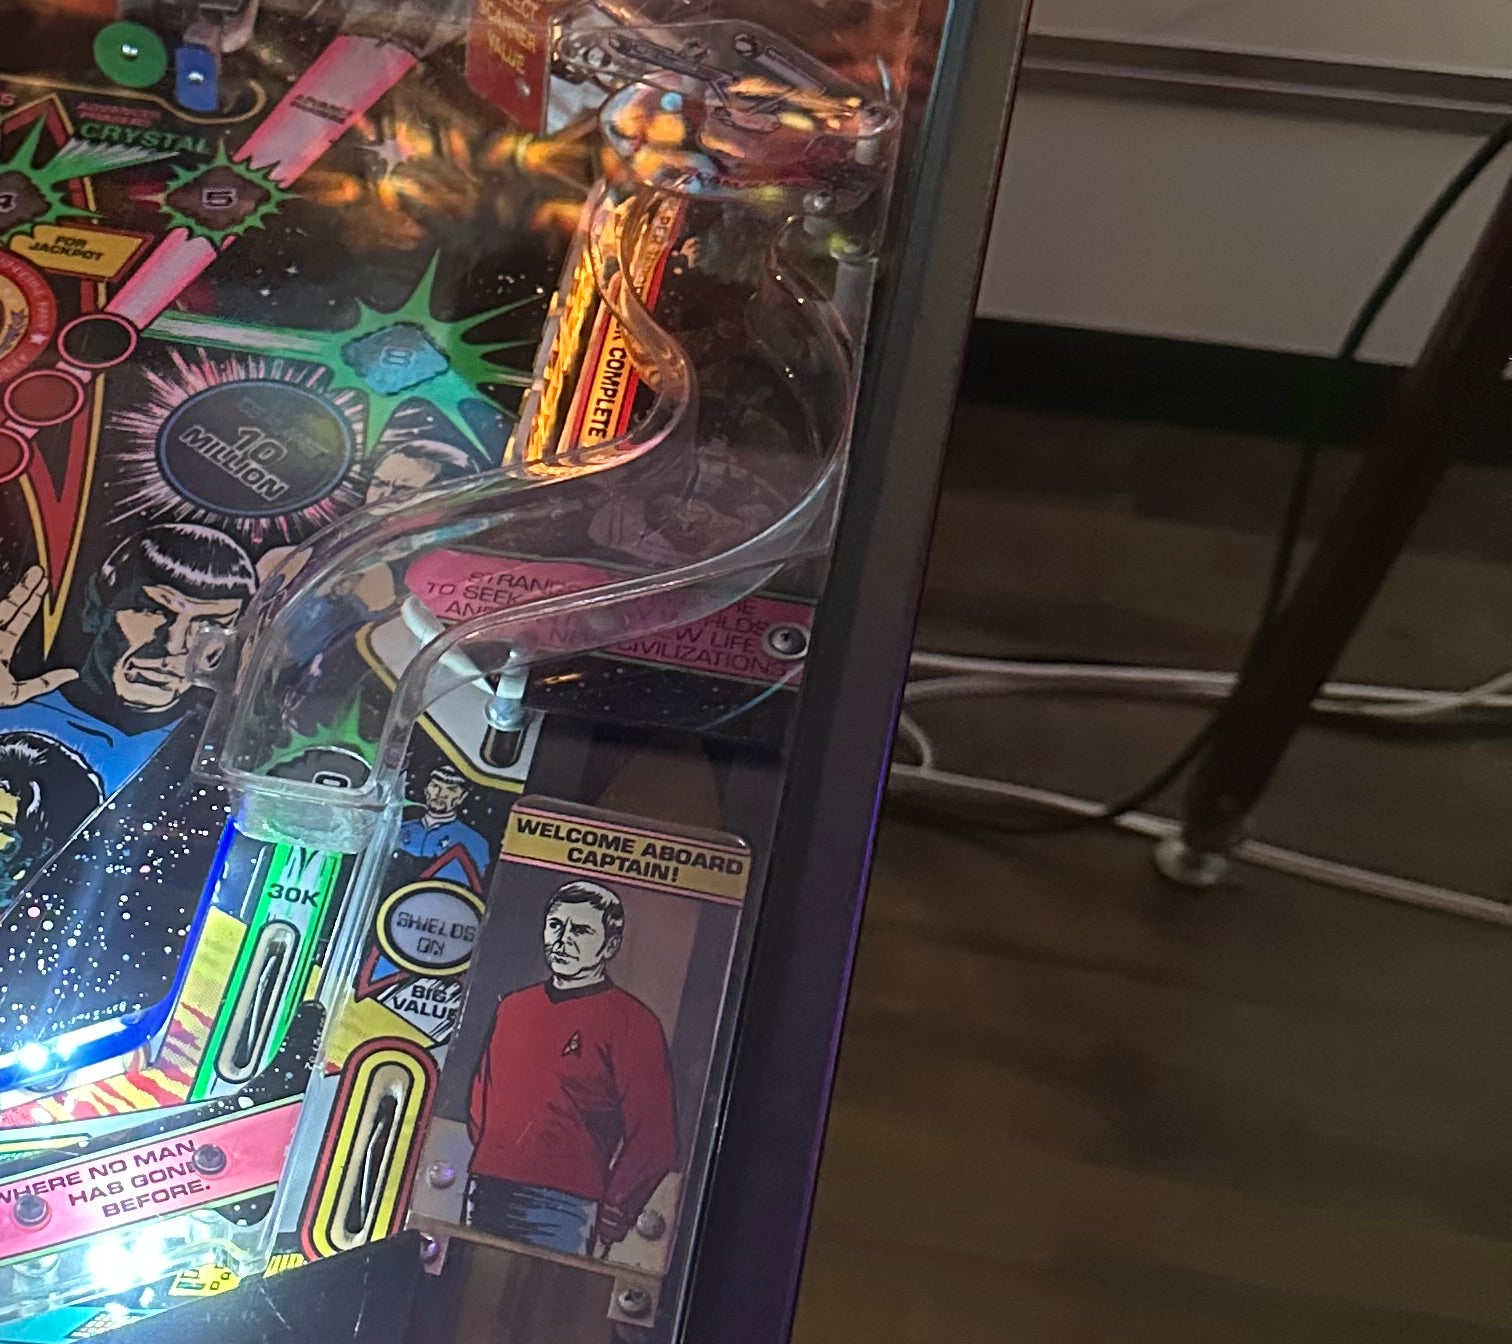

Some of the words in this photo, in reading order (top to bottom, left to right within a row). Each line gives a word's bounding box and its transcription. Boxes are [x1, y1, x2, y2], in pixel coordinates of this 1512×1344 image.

[81, 122, 213, 154] CRYSTAL
[202, 187, 236, 210] 5
[29, 242, 104, 262] JACKPOT
[54, 236, 88, 249] FOR
[588, 346, 627, 439] COMPLETE
[239, 426, 287, 468] 10
[179, 425, 289, 501] MILLION
[427, 582, 455, 595] TO
[710, 632, 758, 652] LIFE
[517, 817, 636, 854] WELCOME
[641, 842, 743, 875] ABOARD
[567, 847, 679, 883] CAPTAIN!
[268, 883, 321, 907] 30K
[396, 911, 477, 941] SHIELDS
[416, 937, 446, 956] ON
[411, 984, 449, 1002] BIG
[88, 1159, 128, 1181] NO
[133, 1140, 196, 1167] MAN
[68, 1180, 124, 1207] HAS
[101, 1178, 211, 1218] BEFORE.
